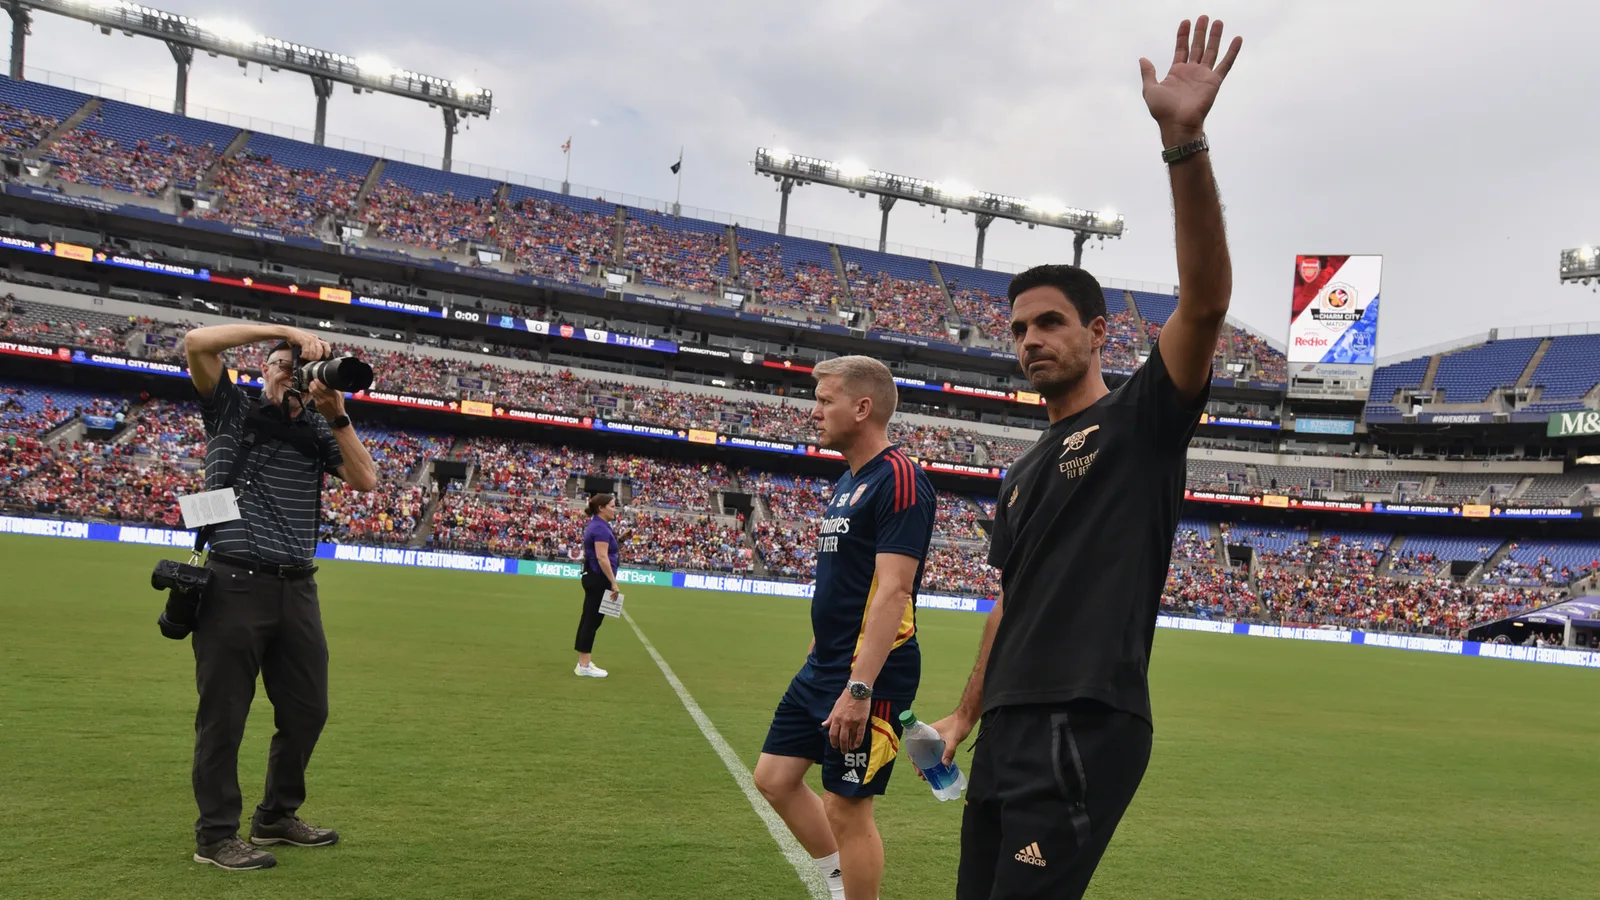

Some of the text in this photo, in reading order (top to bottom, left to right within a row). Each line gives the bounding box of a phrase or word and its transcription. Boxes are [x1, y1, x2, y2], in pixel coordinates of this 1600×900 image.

[2, 236, 35, 249] MATCH
[112, 255, 195, 276] CHARM CITY MATCH
[359, 296, 429, 313] CHARM CITY MATCH
[455, 310, 479, 322] 0:00
[629, 336, 655, 348] HALF
[18, 344, 53, 356] MATCH
[91, 354, 181, 374] CHARM CITY MATCH
[369, 391, 444, 408] CHARM CITY MATCH
[509, 408, 579, 425] CHARM CITY MATCH
[1431, 415, 1480, 424] #RAVENSFLOCK
[607, 421, 674, 437] CHARM CITY MATCH
[731, 437, 794, 451] CHARM CITY MATCH
[1193, 491, 1250, 503] CHARM CITY MATCH
[1302, 499, 1361, 510] CHARM CITY MATCH
[1386, 504, 1449, 514] CHARM CITY MATCH
[1505, 507, 1572, 516] CHARM CITY MATCH
[172, 531, 196, 548] NOW
[334, 544, 382, 562] AVAILABLE
[382, 548, 404, 565] NOW
[404, 550, 416, 566] AT
[535, 562, 563, 577] M&T
[631, 571, 656, 584] Bank
[724, 578, 742, 592] NOW
[742, 579, 753, 593] AT
[844, 752, 867, 768] SR
[1014, 853, 1047, 867] adidas
